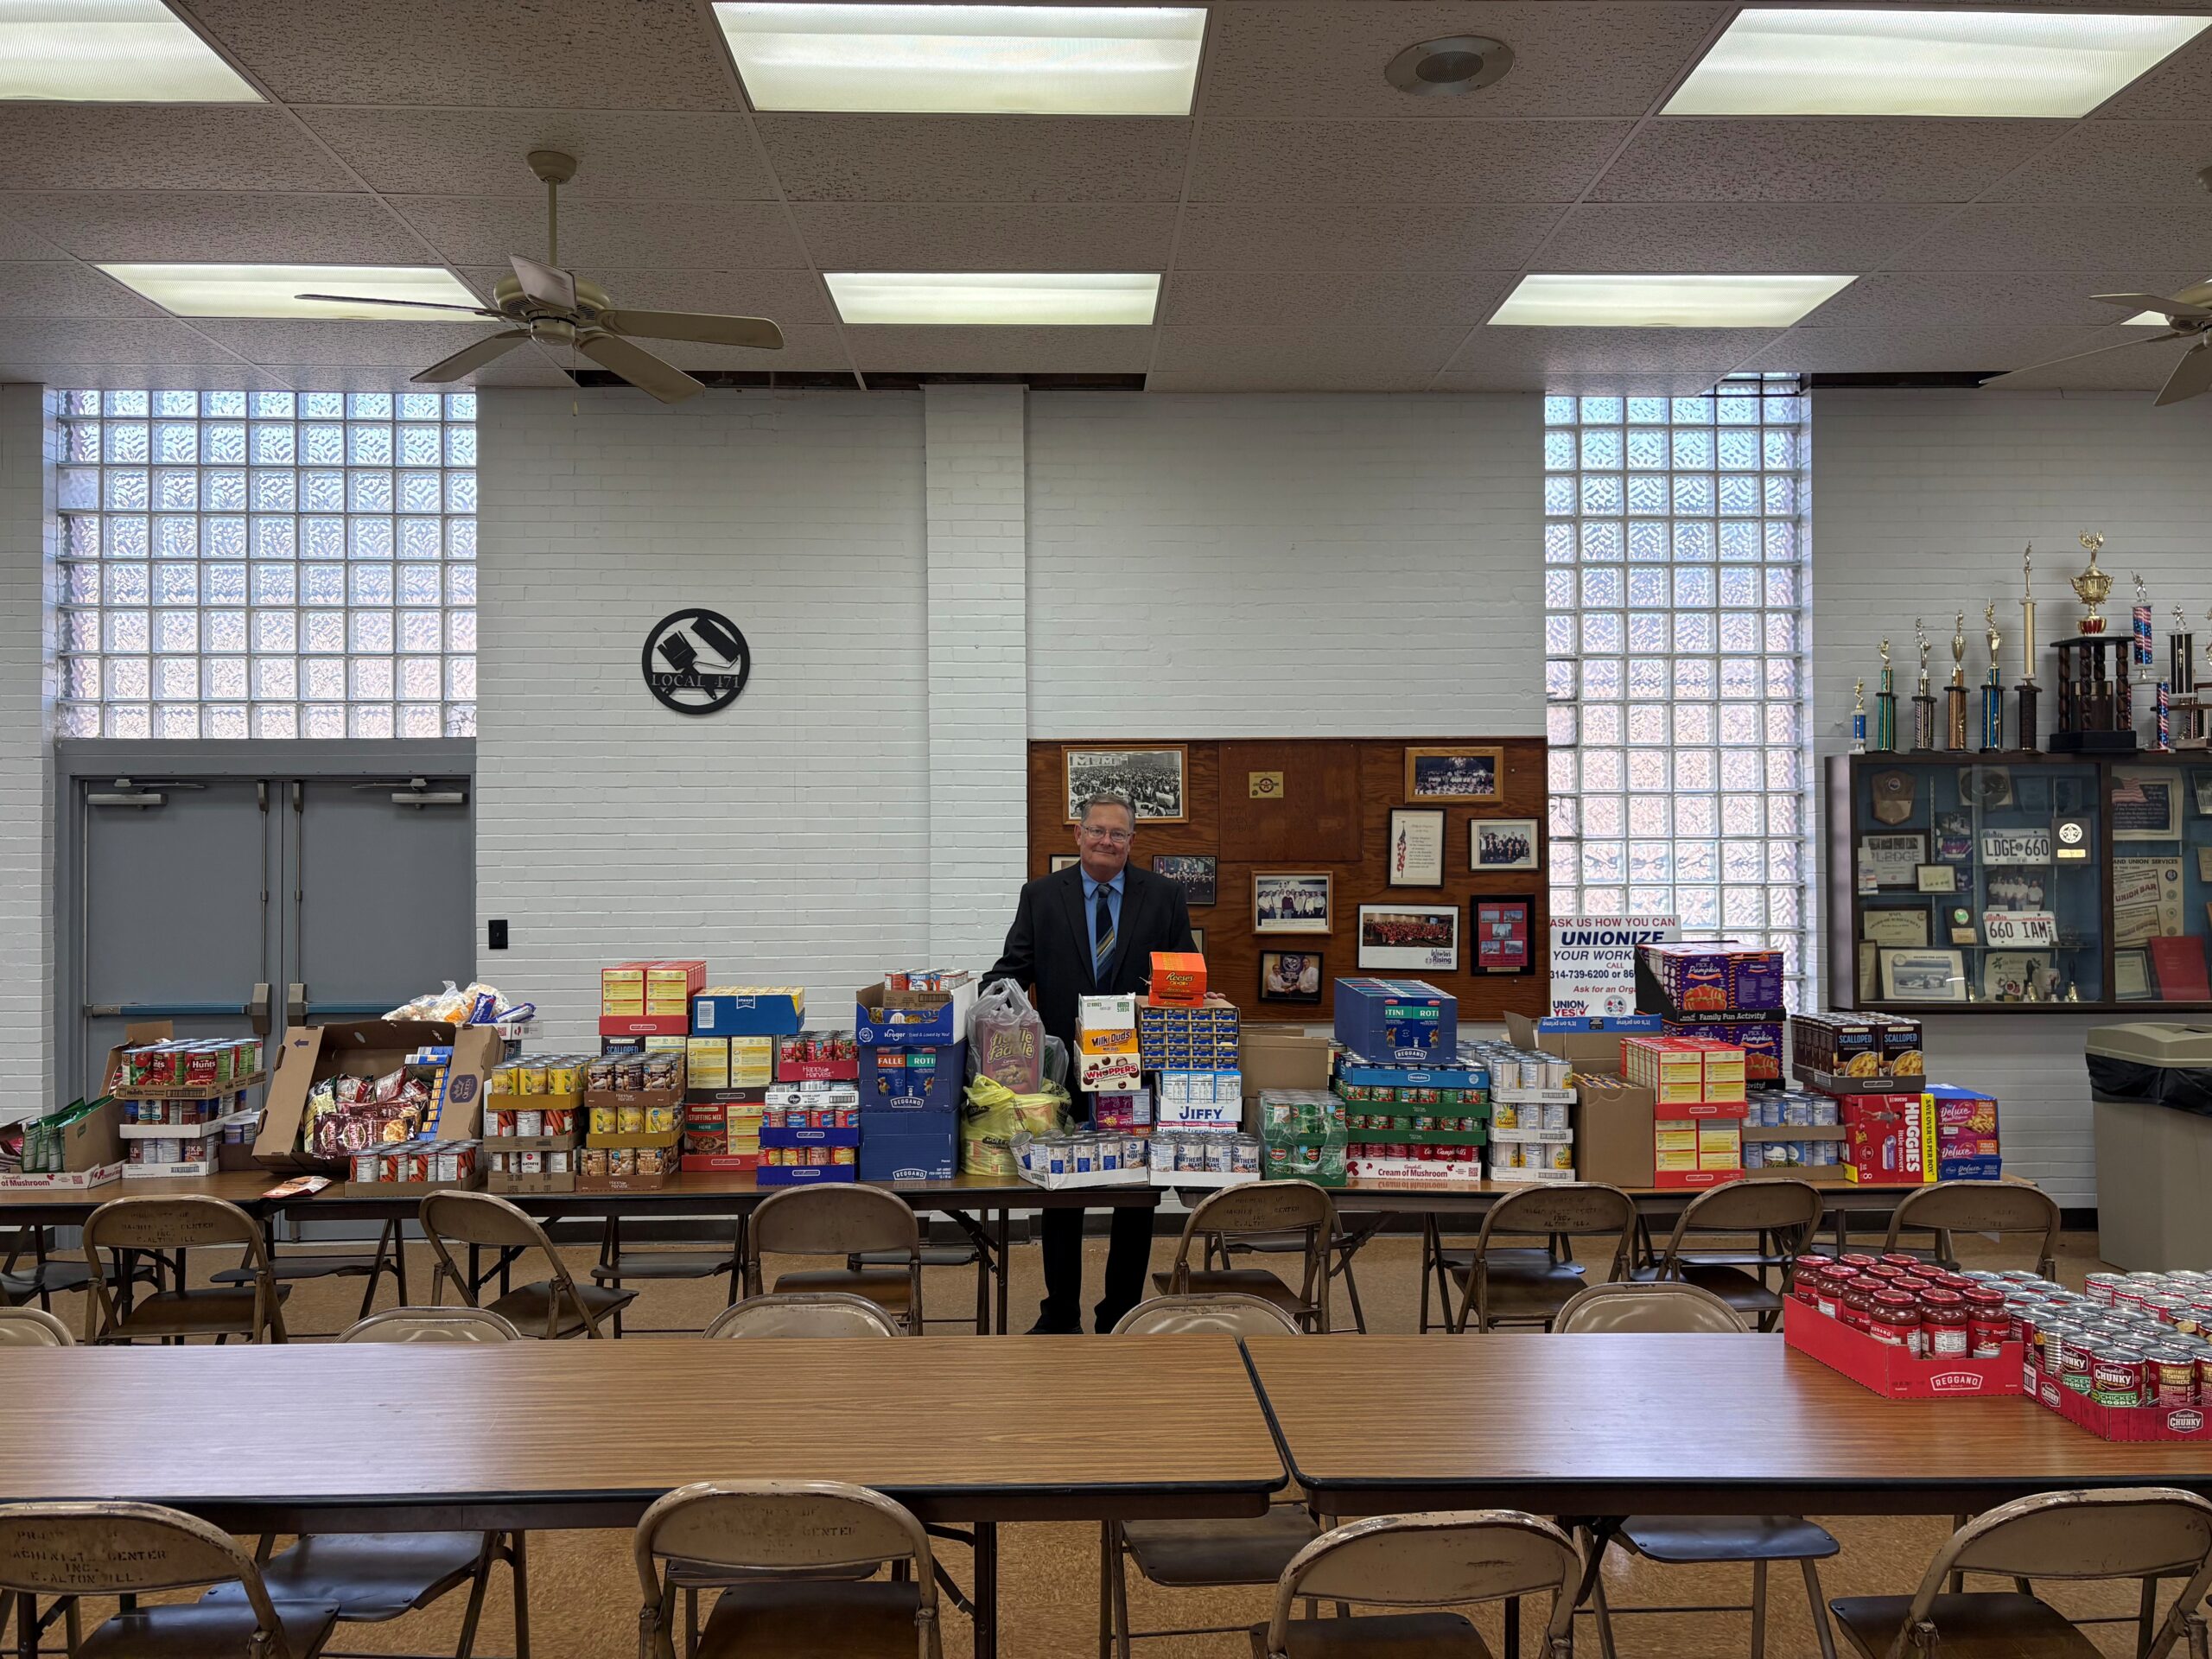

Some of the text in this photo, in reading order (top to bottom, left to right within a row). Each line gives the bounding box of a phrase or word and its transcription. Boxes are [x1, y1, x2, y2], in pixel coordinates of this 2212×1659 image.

[651, 674, 741, 689] LOCAL 471
[1985, 839, 2049, 856] LDGE 660
[2115, 883, 2157, 902] UNION BAR
[1550, 918, 1675, 927] ASK US HOW YOU CAN
[1989, 922, 2048, 938] 660 IAM
[1561, 931, 1664, 945] UNIONIZE
[1433, 956, 1452, 964] Rising
[1554, 950, 1635, 961] YOUR WORK
[1550, 969, 1609, 979] 314-739-6200
[1623, 969, 1635, 978] 86
[1688, 965, 1721, 975] Pumpkin
[1166, 971, 1194, 982] Reese's
[1553, 1000, 1585, 1008] UNION
[1737, 1012, 1766, 1020] Activity!
[884, 1028, 906, 1041] Kroger
[1091, 1031, 1131, 1047] Milk Duds
[1741, 1033, 1773, 1044] Pumpkin
[1839, 1033, 1917, 1044] SCALLOPED SCALLOPED
[607, 1046, 639, 1054] SCALLOPED
[1085, 1064, 1138, 1079] WHOPPERS
[1941, 1104, 1970, 1117] Deluxe
[1905, 1102, 1920, 1172] HUGGIES
[1942, 1145, 1973, 1158] Deluxe
[1410, 1168, 1447, 1177] Mushroom
[1958, 1164, 1981, 1173] Deluxe
[2100, 1365, 2125, 1375] Campbell's
[1936, 1376, 1978, 1387] REGGANO
[2094, 1370, 2132, 1385] CHUNKY
[2042, 1387, 2059, 1404] CHUNKY
[2170, 1417, 2202, 1427] CHUNKY
[108, 1549, 167, 1560] CENTER
[66, 1564, 99, 1573] INC.
[51, 1574, 95, 1584] ALTON
